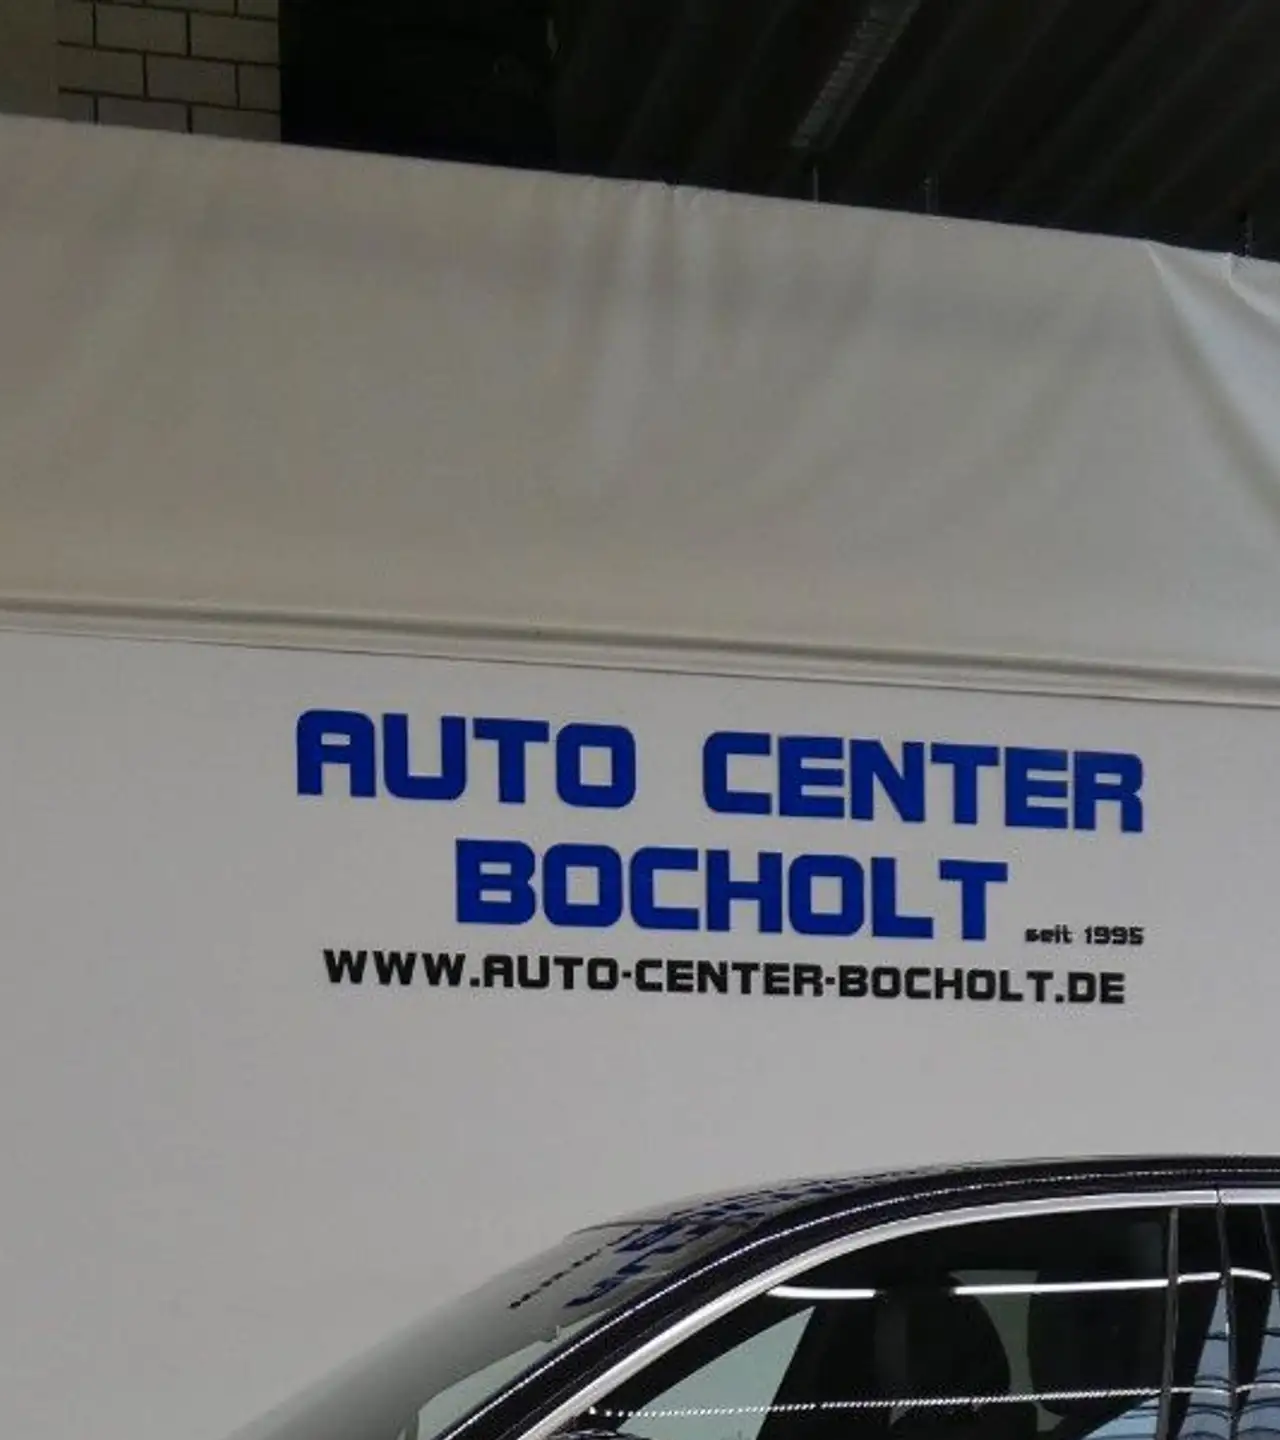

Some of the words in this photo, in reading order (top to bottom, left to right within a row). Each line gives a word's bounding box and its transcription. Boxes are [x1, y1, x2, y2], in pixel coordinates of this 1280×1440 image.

[296, 708, 637, 808] AUTO
[702, 731, 1144, 833] CENTER
[456, 838, 1008, 941] BOCHOLT
[1024, 923, 1073, 945] seit
[1084, 925, 1145, 945] 1995
[322, 948, 1126, 1005] WWW.AUTO-CENTER-BOCHOLT.DE
